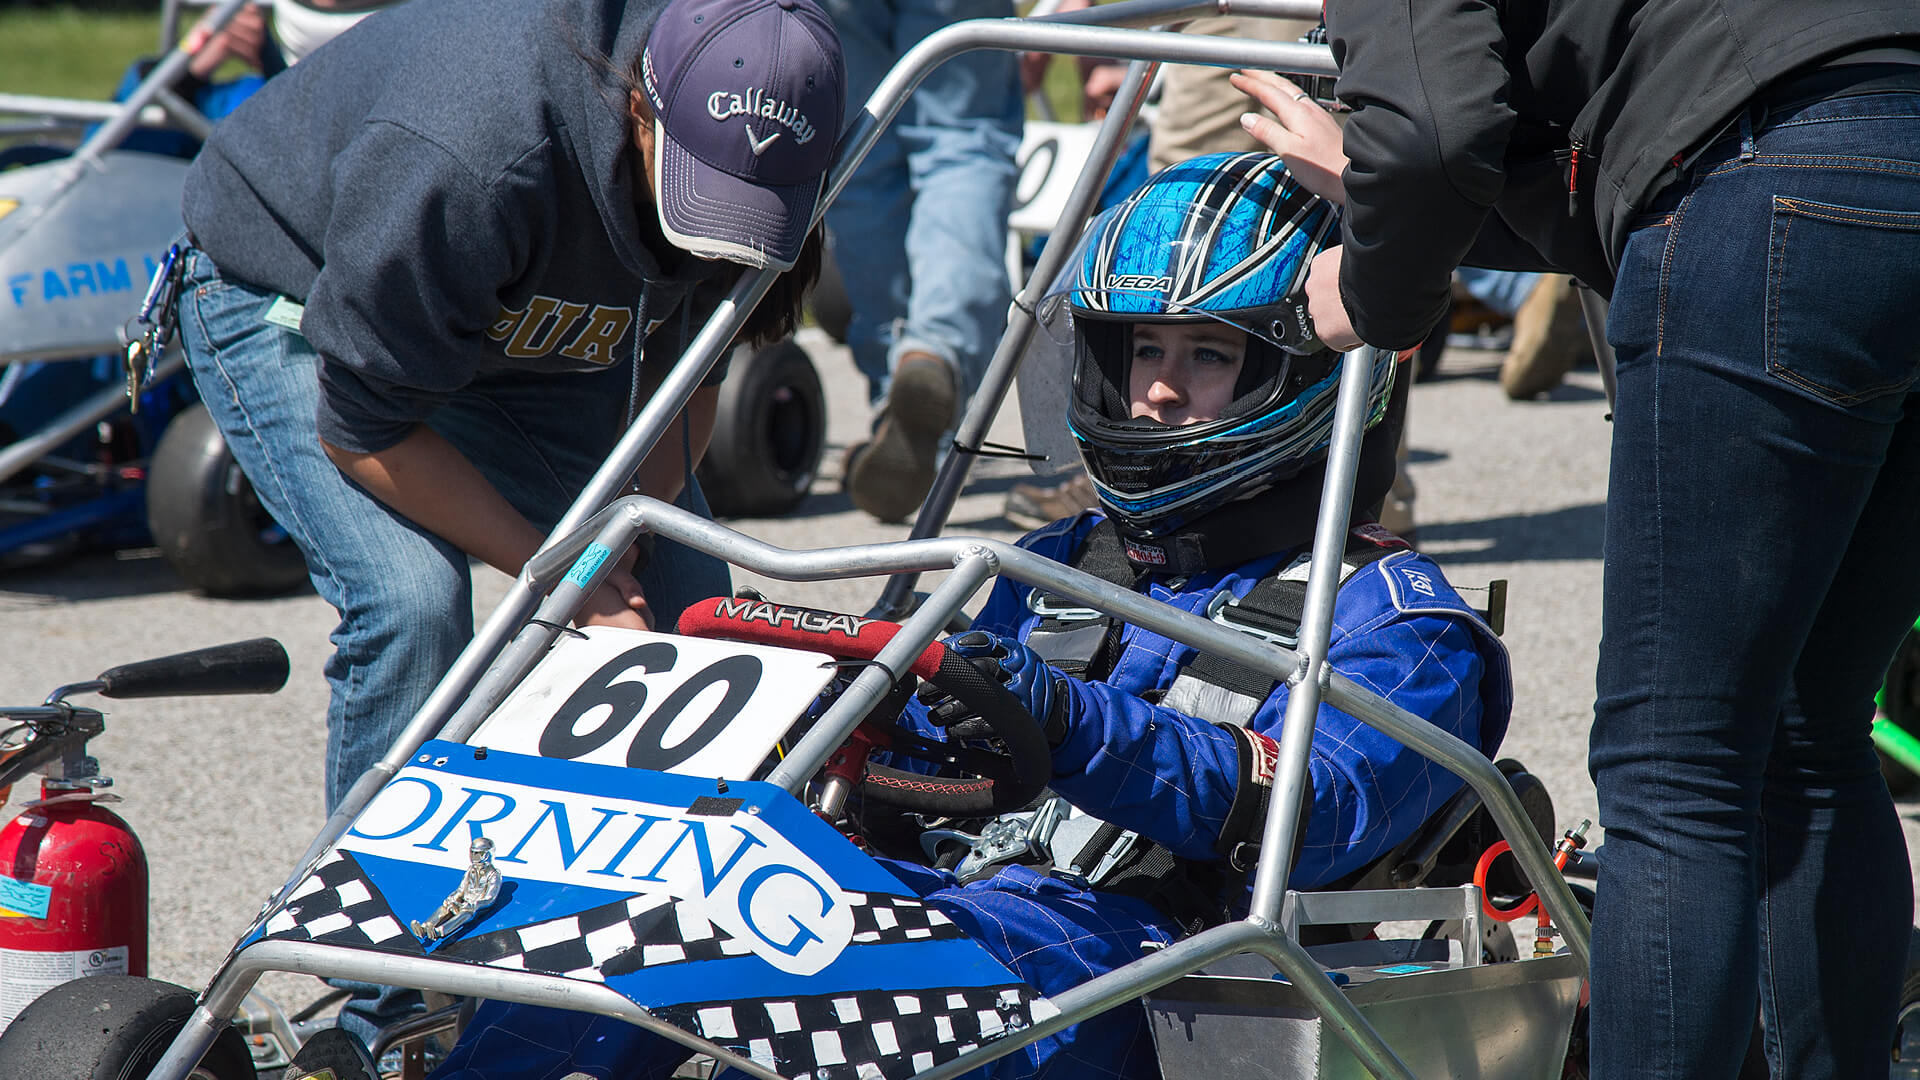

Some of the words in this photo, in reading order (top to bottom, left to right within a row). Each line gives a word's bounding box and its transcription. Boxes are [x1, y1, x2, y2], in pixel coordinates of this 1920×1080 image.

[707, 87, 817, 145] Callaway
[8, 257, 133, 308] FARM
[1106, 274, 1173, 293] VEGA
[484, 295, 664, 365] PUR
[539, 642, 762, 771] 60
